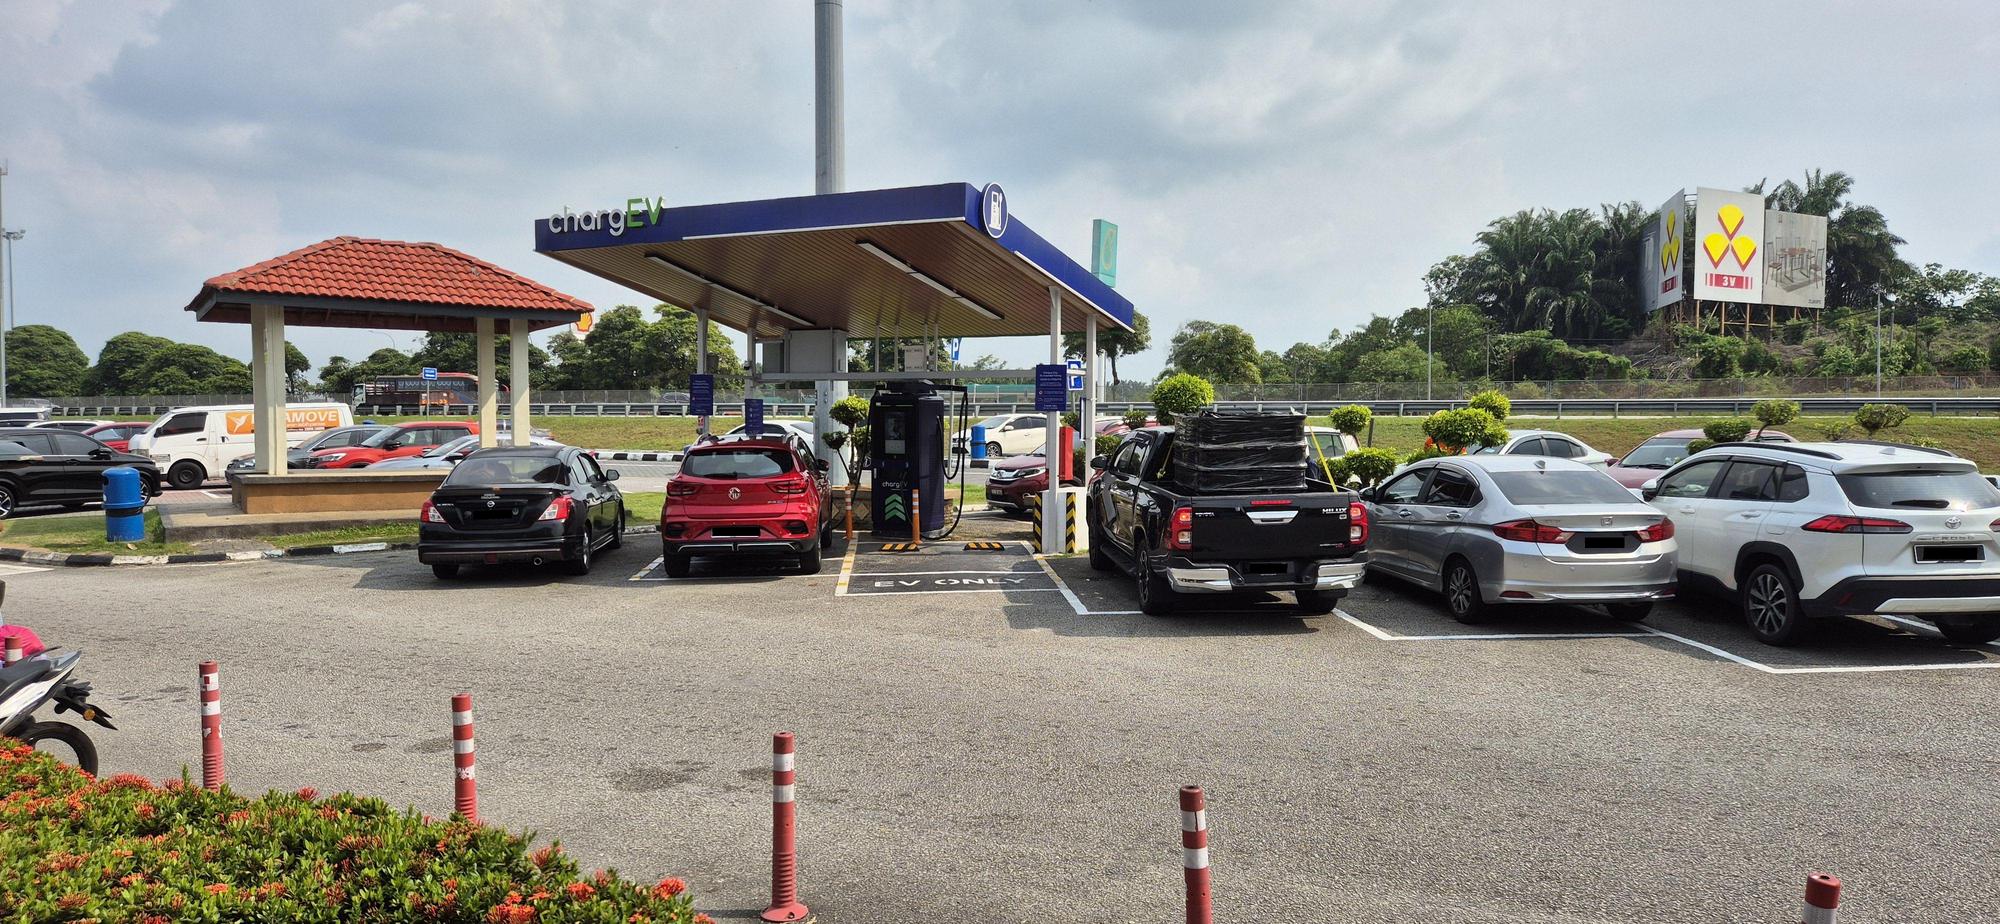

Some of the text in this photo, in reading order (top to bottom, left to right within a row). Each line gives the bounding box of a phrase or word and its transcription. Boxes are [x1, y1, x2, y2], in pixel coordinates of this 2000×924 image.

[548, 196, 663, 236] chargEV
[1722, 276, 1736, 287] 3V
[874, 577, 1025, 588] EV ONLY
